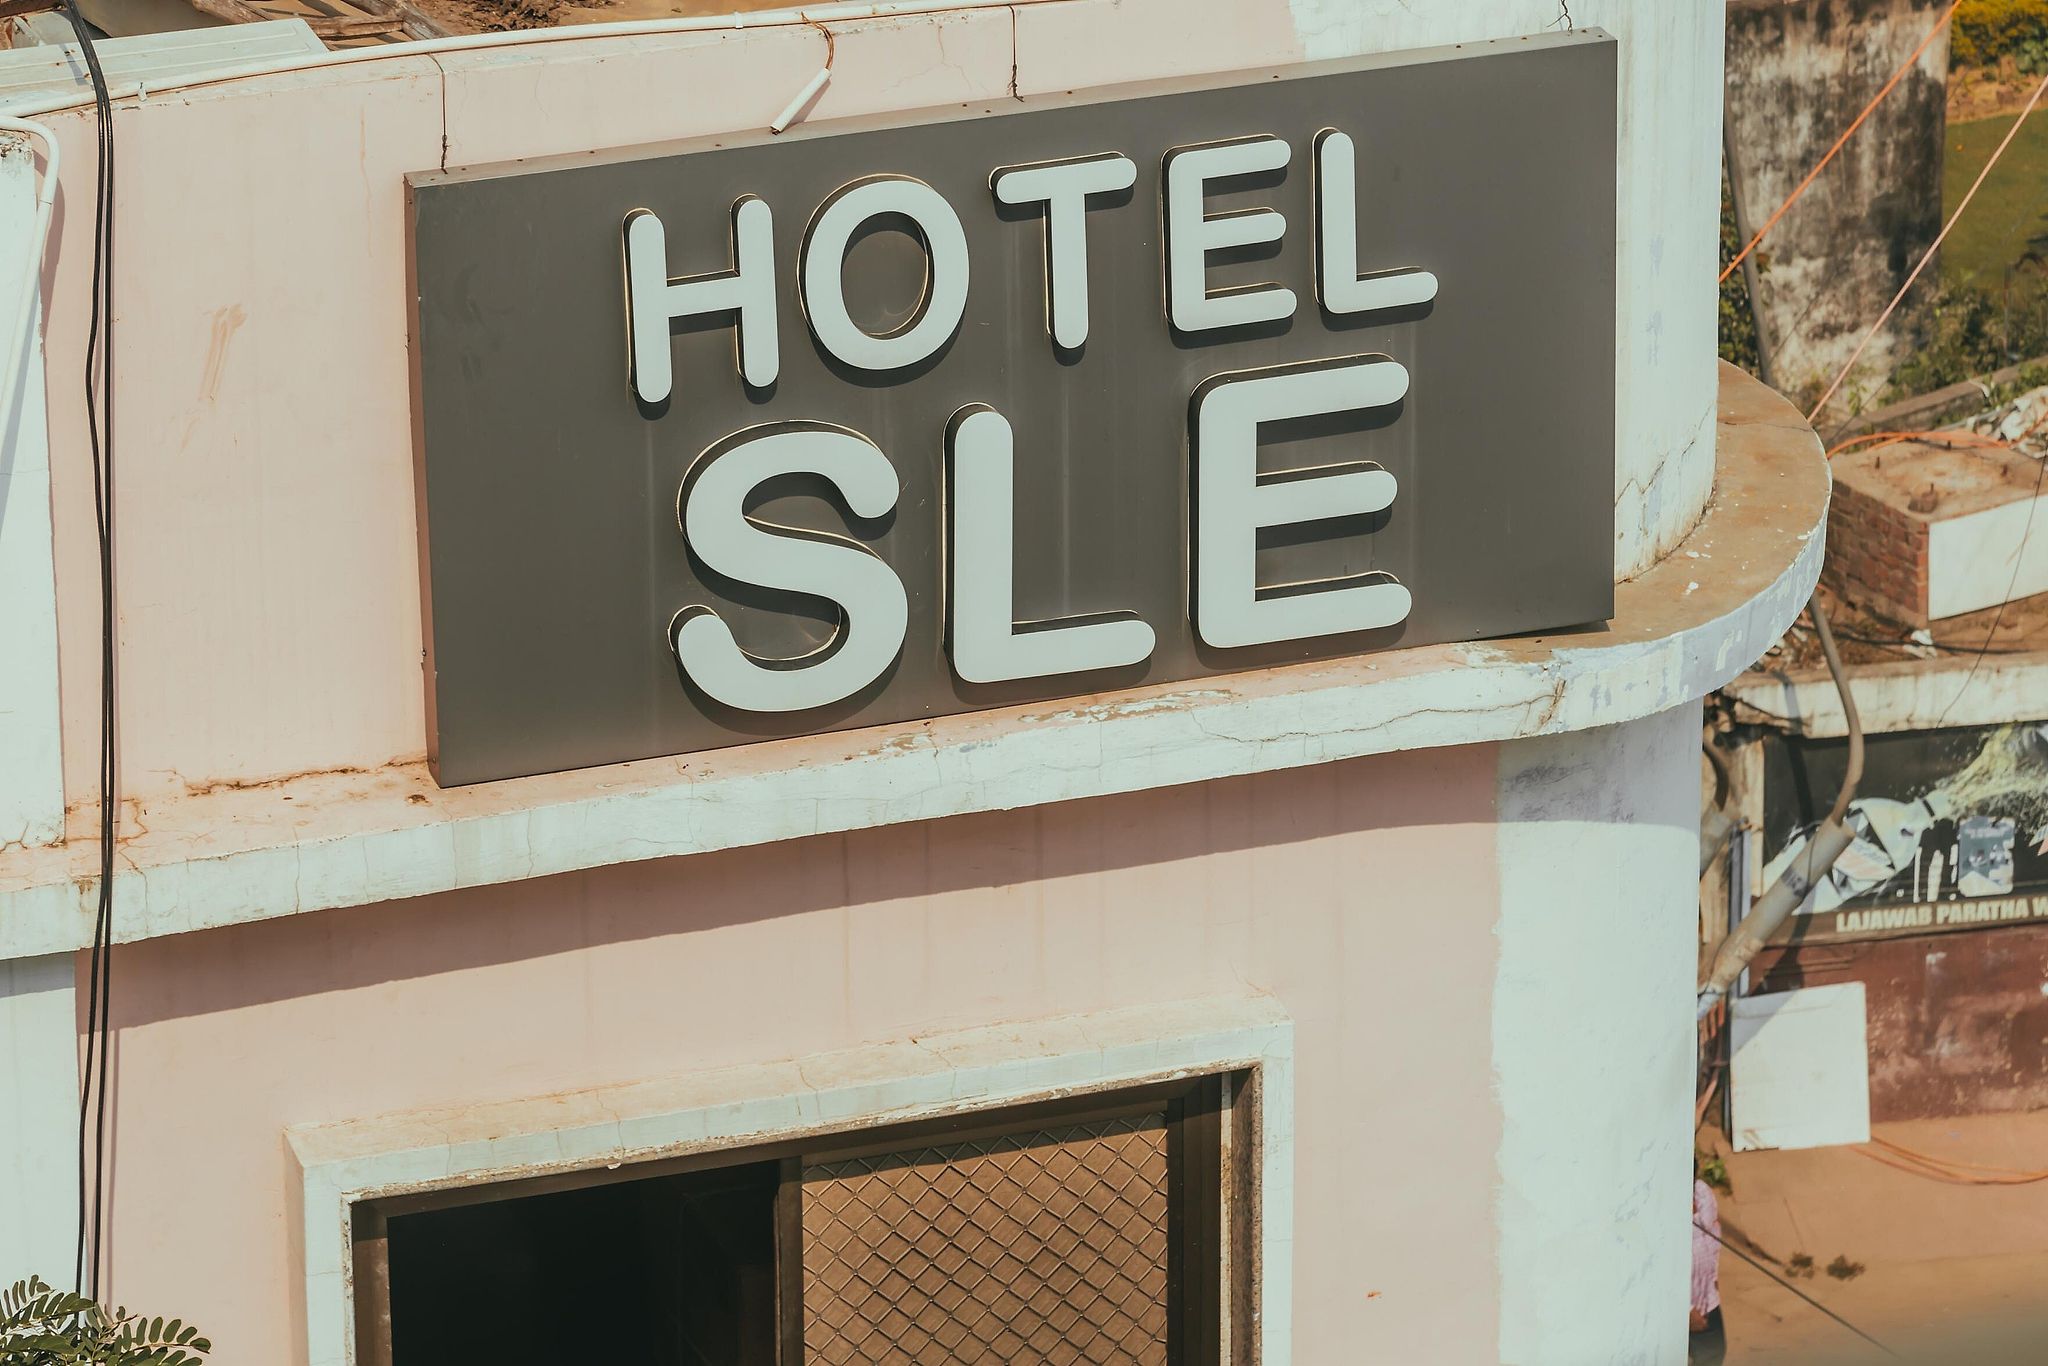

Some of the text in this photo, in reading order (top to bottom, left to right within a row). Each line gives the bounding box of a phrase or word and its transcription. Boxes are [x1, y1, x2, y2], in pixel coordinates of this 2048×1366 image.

[624, 127, 1440, 403] HOTEL
[672, 354, 1413, 712] SLE
[1836, 905, 1932, 932] LAJAWAB
[1936, 898, 2030, 924] PARATHA
